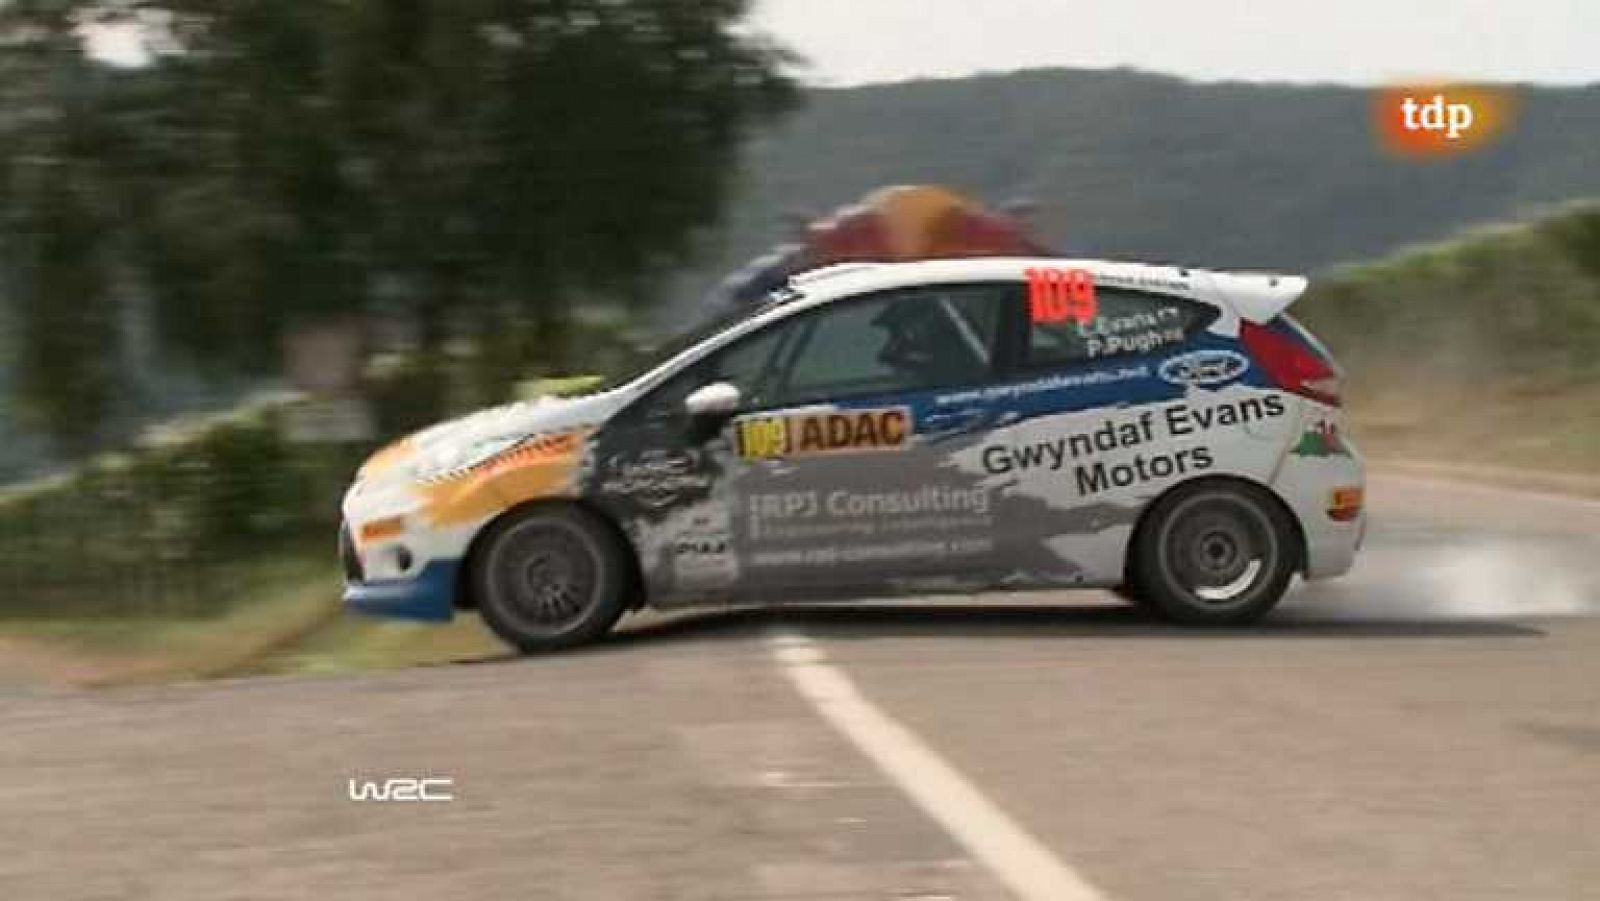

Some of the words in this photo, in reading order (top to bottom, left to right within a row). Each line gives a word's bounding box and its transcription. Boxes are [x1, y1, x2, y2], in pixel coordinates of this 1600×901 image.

[1024, 267, 1097, 323] 109
[740, 415, 789, 458] 109
[801, 410, 907, 451] ADAC
[982, 411, 1154, 474] Gwyndaf
[1166, 394, 1285, 436] Evans
[1075, 445, 1214, 497] Motors
[828, 484, 989, 514] Consulting
